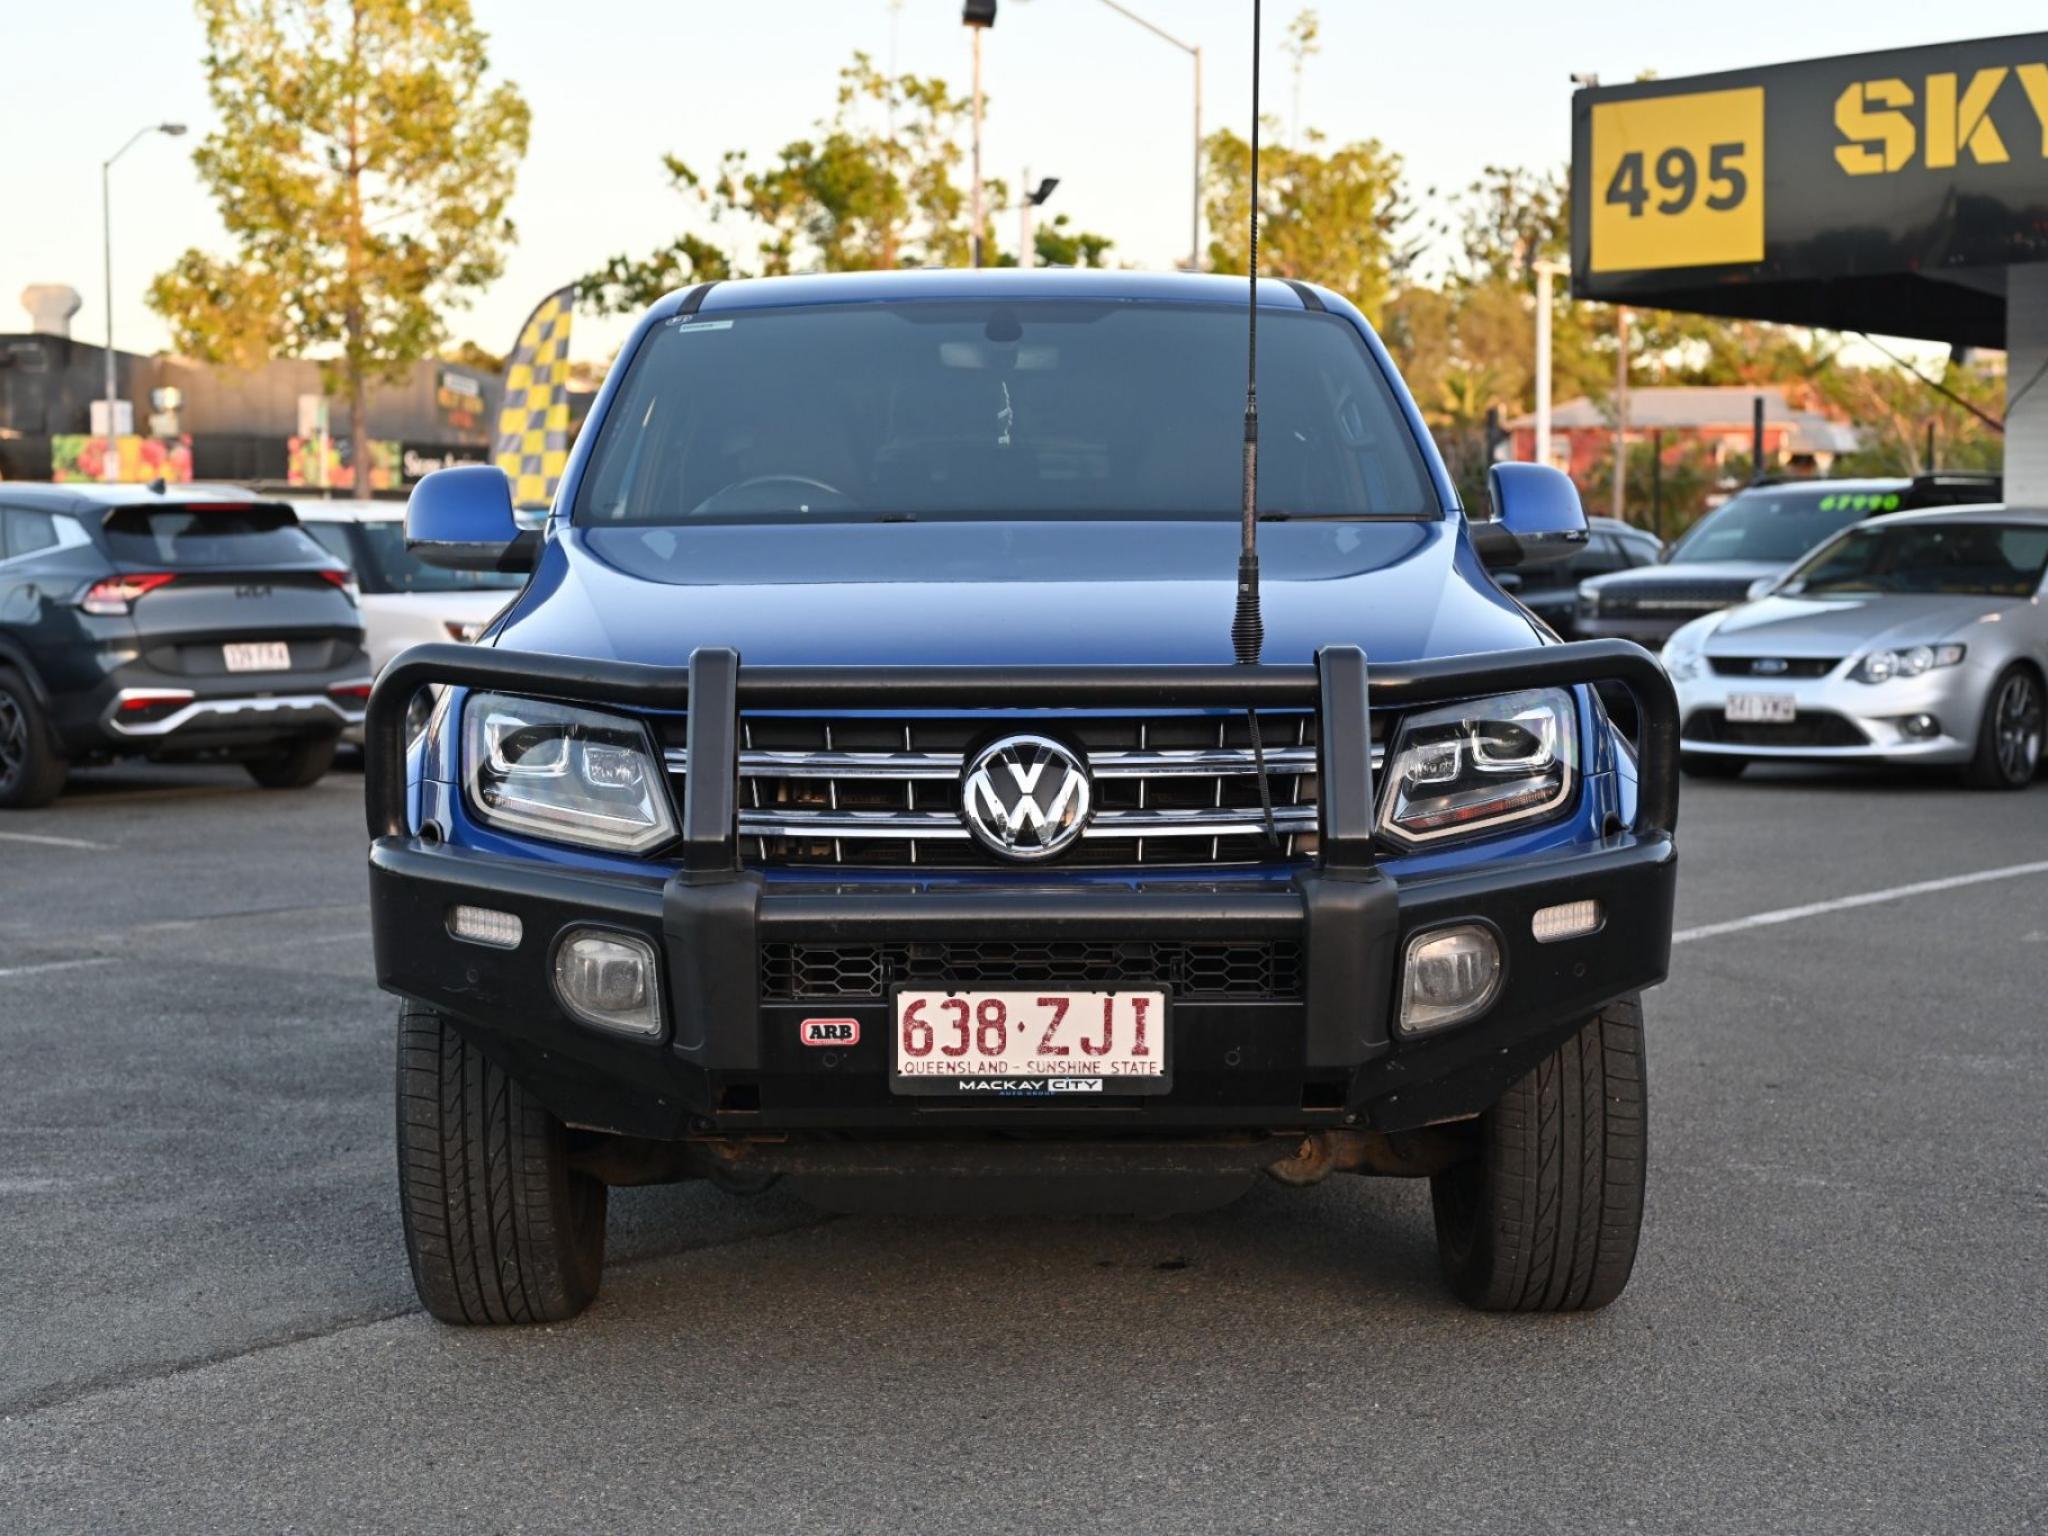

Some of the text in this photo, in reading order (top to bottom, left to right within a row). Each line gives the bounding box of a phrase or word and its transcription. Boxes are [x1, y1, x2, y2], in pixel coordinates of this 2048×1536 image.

[1605, 142, 1747, 218] 495
[809, 1024, 852, 1040] ARB
[904, 1060, 1158, 1075] QUEENSLAND SUNSHINE STATE
[958, 1079, 1046, 1091] MACKAY
